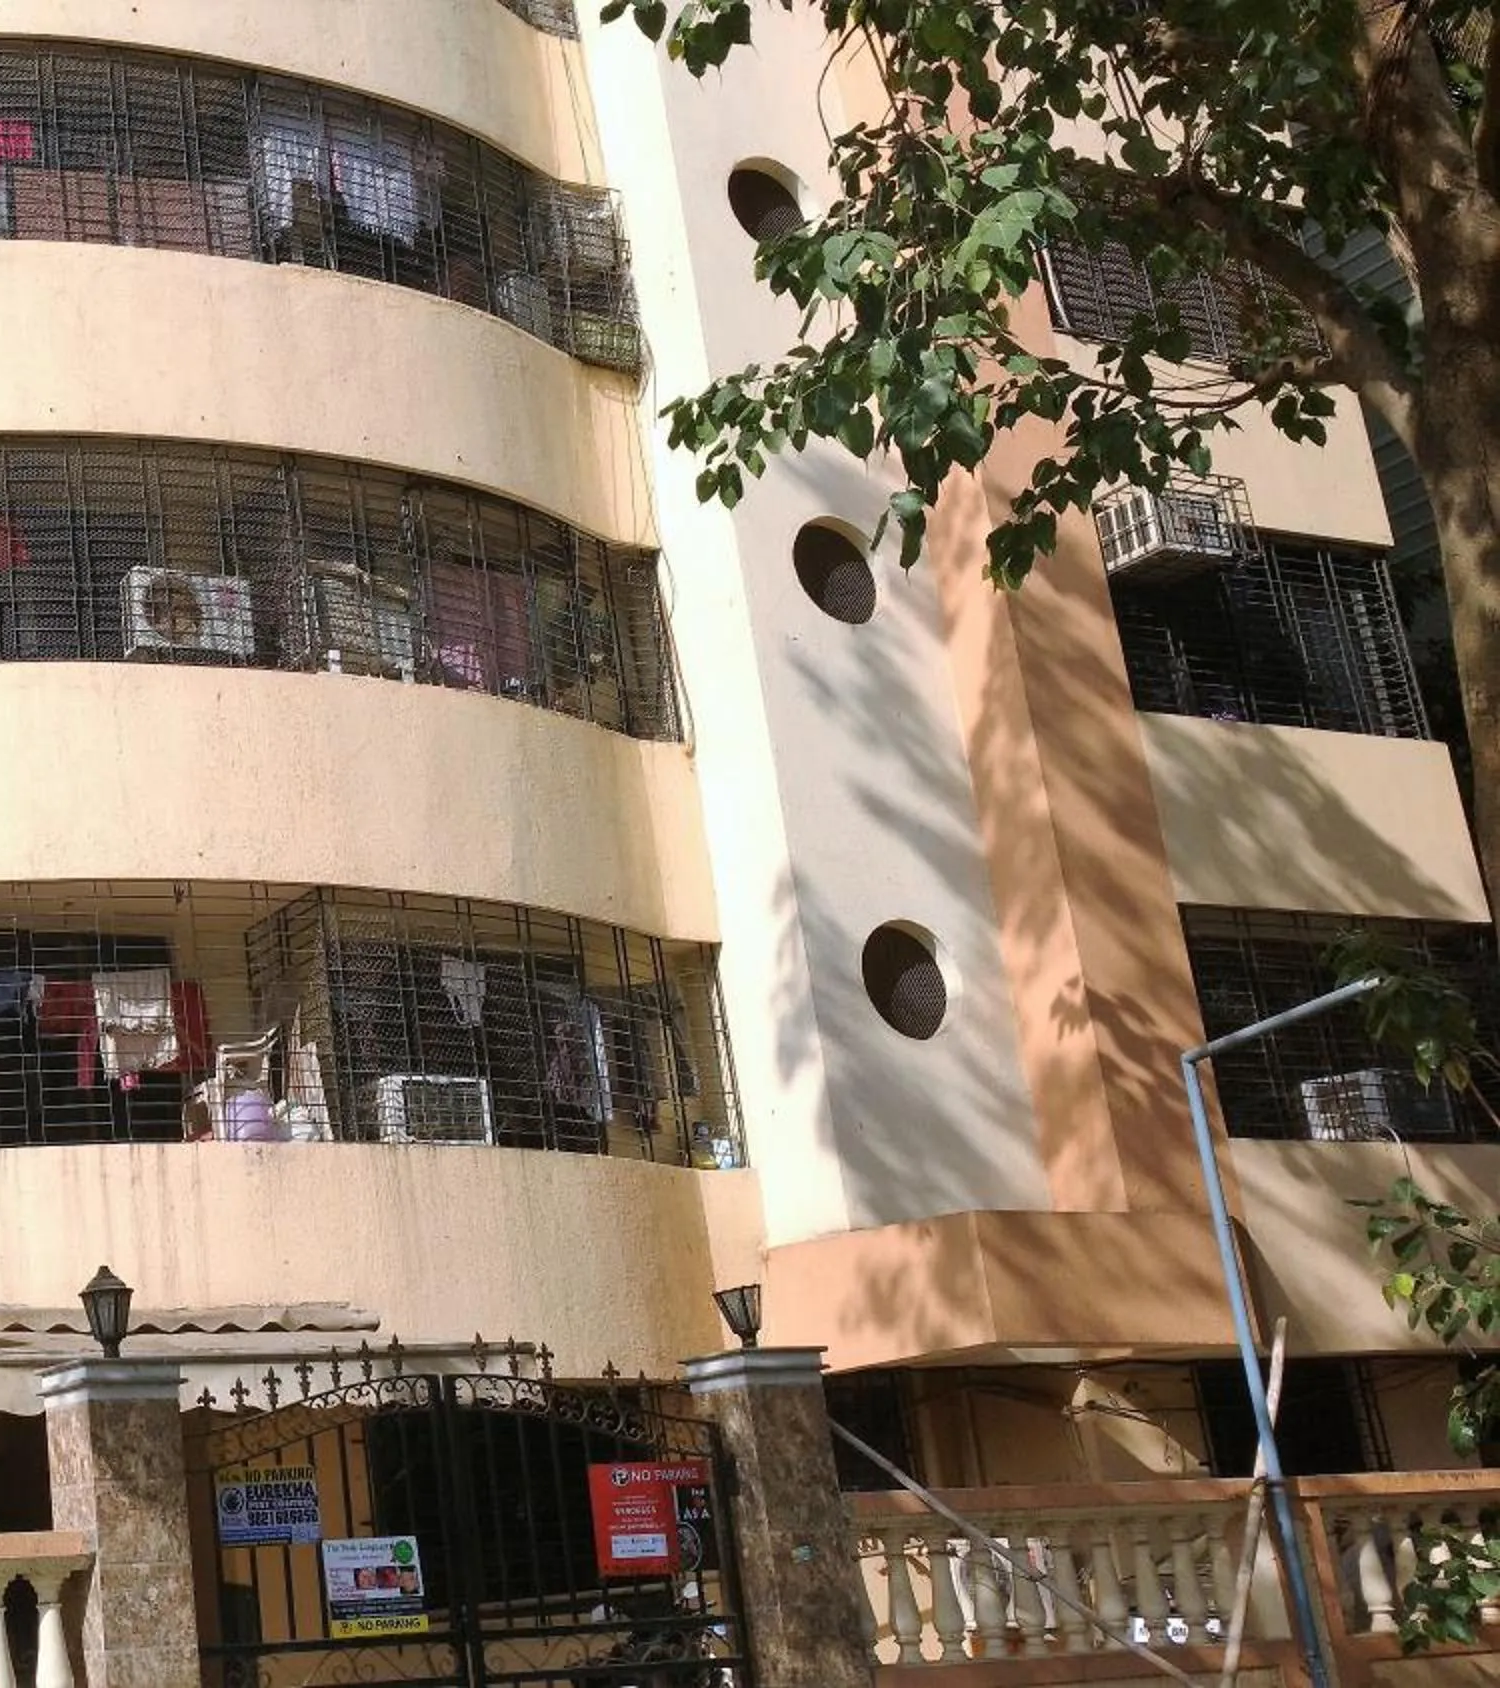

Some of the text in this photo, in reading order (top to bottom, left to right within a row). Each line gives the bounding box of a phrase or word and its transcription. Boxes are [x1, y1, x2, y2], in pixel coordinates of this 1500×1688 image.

[245, 1470, 261, 1482] NO
[263, 1467, 313, 1481] PARKING
[631, 1470, 651, 1482] NO
[245, 1482, 315, 1499] EUREKHA
[357, 1617, 421, 1631] NO PARKING
